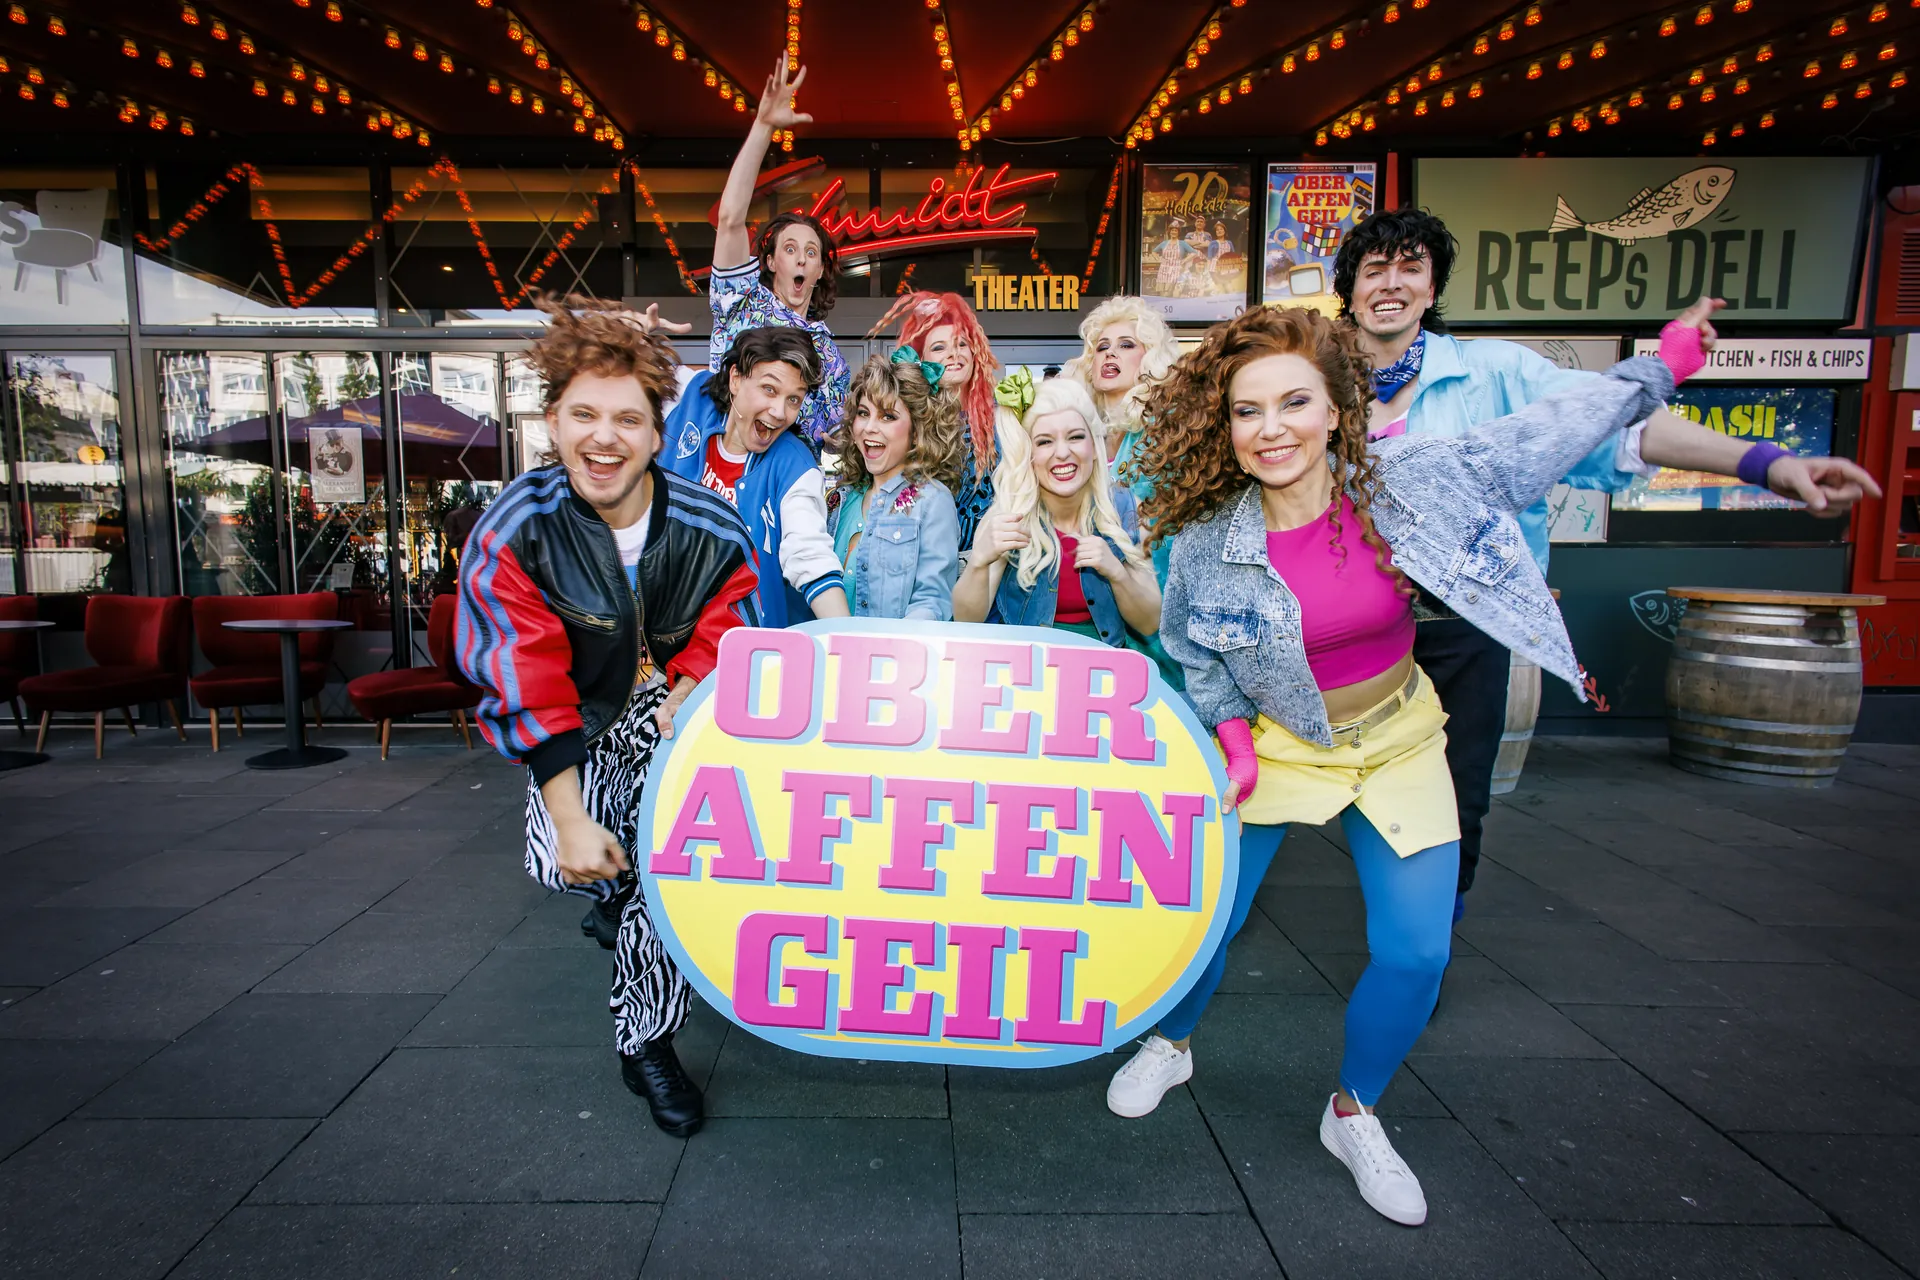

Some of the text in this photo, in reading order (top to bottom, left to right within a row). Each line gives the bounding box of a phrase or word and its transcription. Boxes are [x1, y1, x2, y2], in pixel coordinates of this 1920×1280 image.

[1172, 171, 1229, 212] 20
[1287, 192, 1351, 207] AFFEN
[1293, 175, 1346, 190] OBER
[1297, 209, 1341, 224] GEIL
[1666, 229, 1796, 311] DELI
[972, 275, 1080, 310] THEATER
[1703, 350, 1754, 368] TCHEN
[1771, 350, 1801, 368] FISH
[1807, 351, 1818, 368] &
[1823, 349, 1865, 368] CHIPS
[1668, 404, 1776, 438] RASH
[714, 627, 1156, 761] OBER
[649, 765, 1205, 906] AFFEN
[732, 912, 1106, 1047] GEIL
